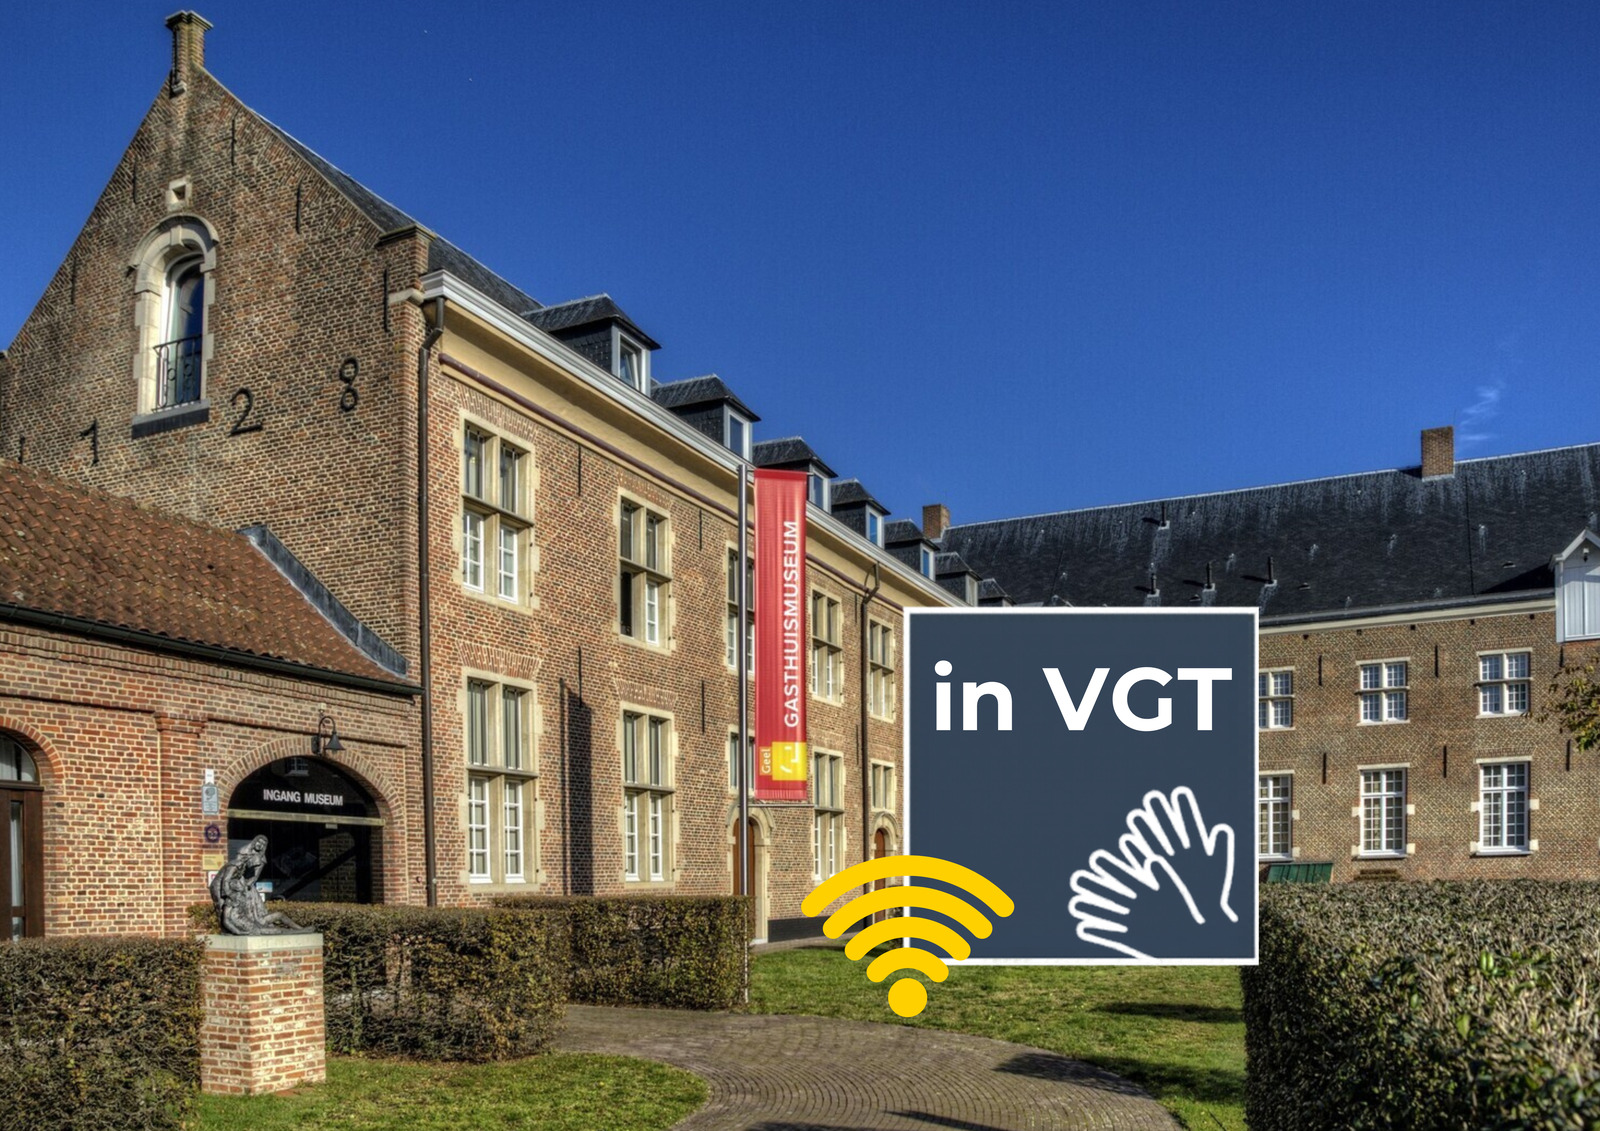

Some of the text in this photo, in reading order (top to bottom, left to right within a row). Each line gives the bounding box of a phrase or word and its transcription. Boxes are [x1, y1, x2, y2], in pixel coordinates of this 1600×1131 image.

[228, 387, 264, 437] 2
[339, 356, 360, 413] 8
[783, 520, 799, 728] GASTHUISMUSEUM
[760, 748, 771, 774] Geel
[263, 788, 344, 806] INGANG MUSEUM
